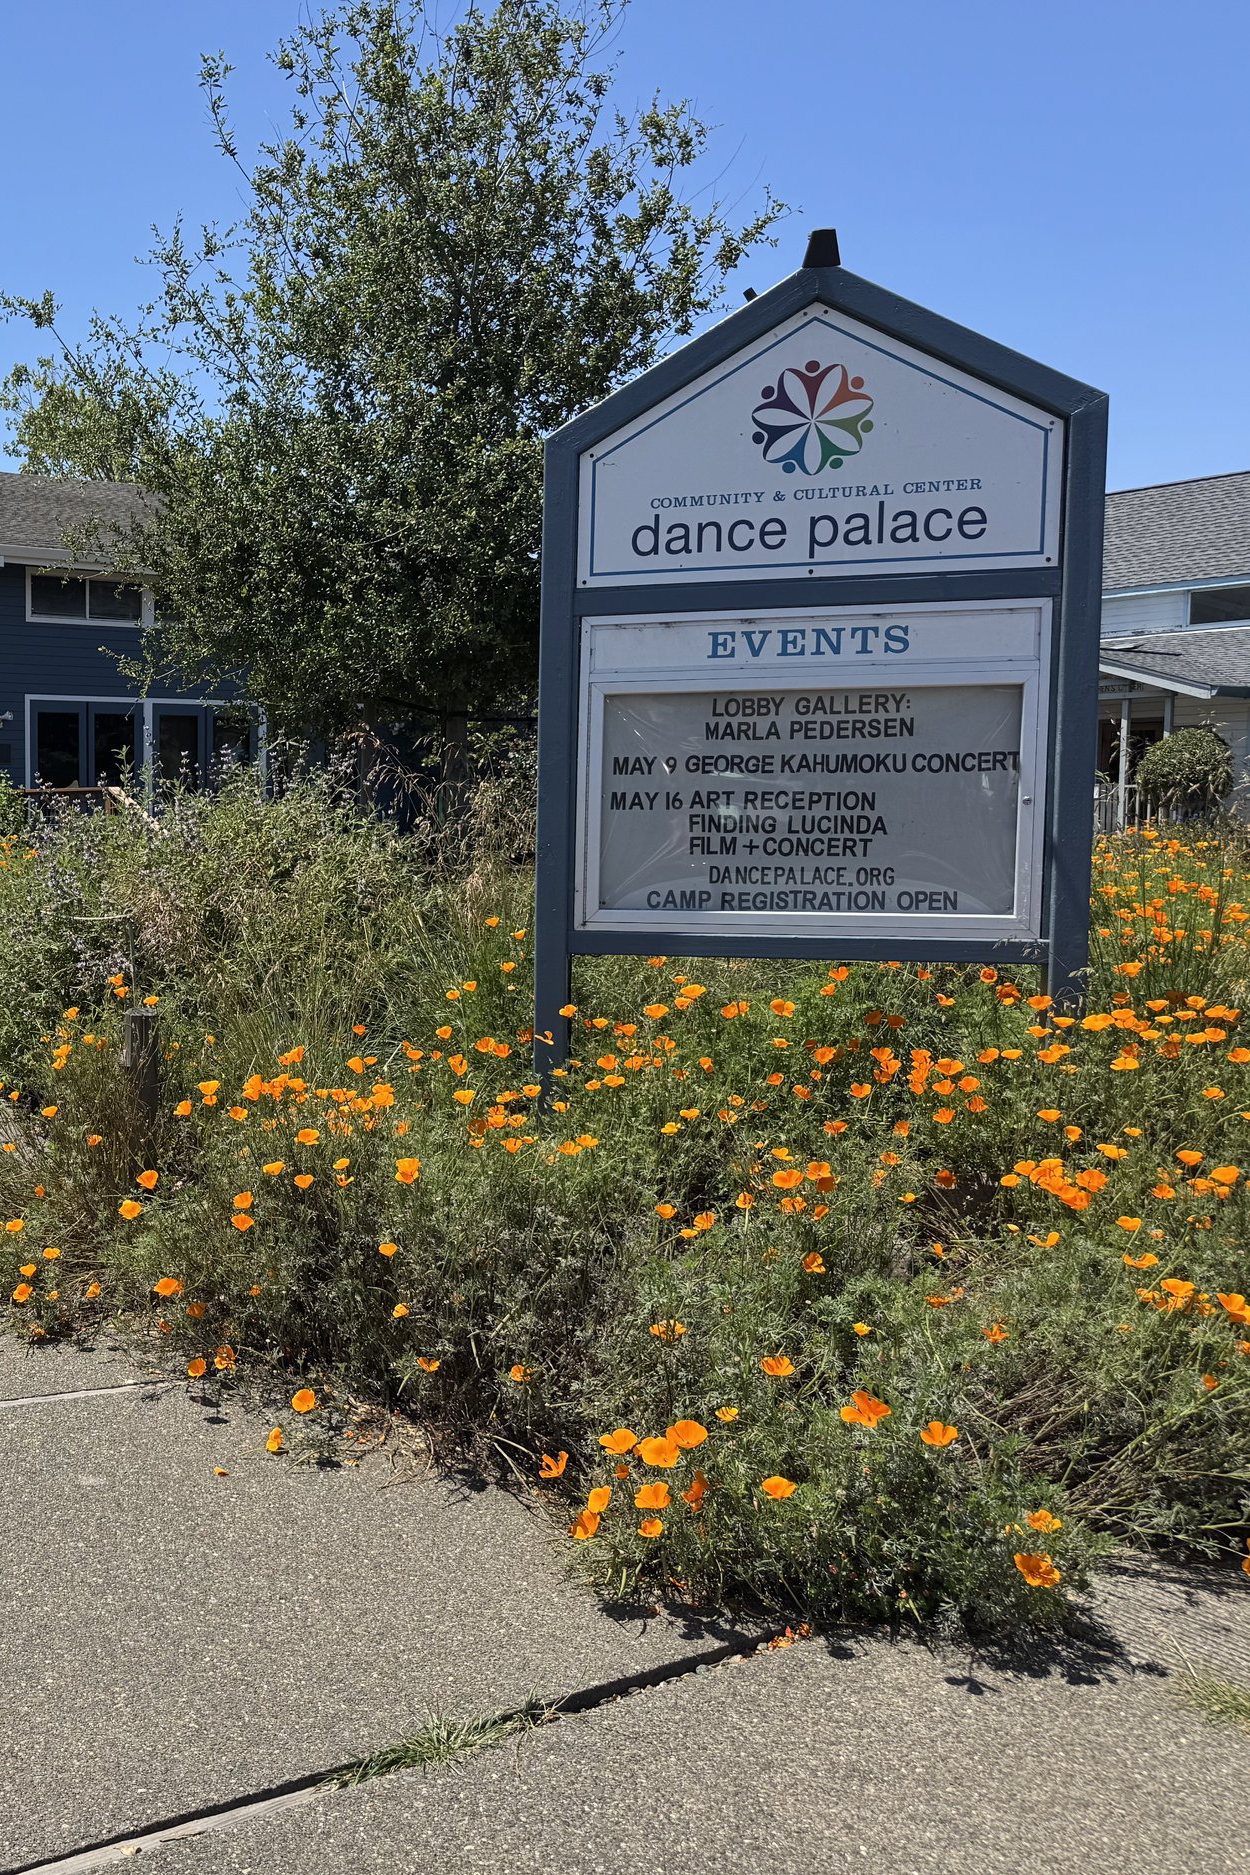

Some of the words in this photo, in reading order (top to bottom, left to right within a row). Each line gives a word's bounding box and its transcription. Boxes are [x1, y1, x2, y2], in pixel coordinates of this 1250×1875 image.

[650, 491, 766, 509] COMMUNITY
[773, 491, 785, 502] &
[793, 484, 894, 500] CULTURAL
[903, 479, 982, 494] CENTER
[632, 515, 787, 556] dance
[808, 502, 988, 558] palace
[708, 625, 909, 659] EVENTS
[712, 696, 785, 717] LOBBY
[795, 694, 911, 716] GALLERY:
[705, 720, 781, 741] MARLA
[790, 718, 914, 739] PEDERSEN
[613, 757, 657, 776] MAY
[666, 757, 677, 774] 9
[685, 755, 774, 774] GEORGE
[781, 754, 906, 773] KAHUMOKU
[912, 751, 1019, 772] CONCERT
[611, 792, 659, 811] MAY
[665, 791, 683, 810] 16
[690, 791, 735, 810] ART
[744, 791, 875, 811] RECEPTION
[689, 815, 776, 834] FINDING
[787, 815, 887, 835] LUCINDA
[690, 837, 737, 855] FILM
[763, 838, 872, 857] CONCERT
[709, 866, 895, 887] DANCEPALACE.ORG
[647, 891, 711, 909] CAMP
[721, 890, 885, 912] REGISTRATION
[897, 891, 958, 911] OPEN
